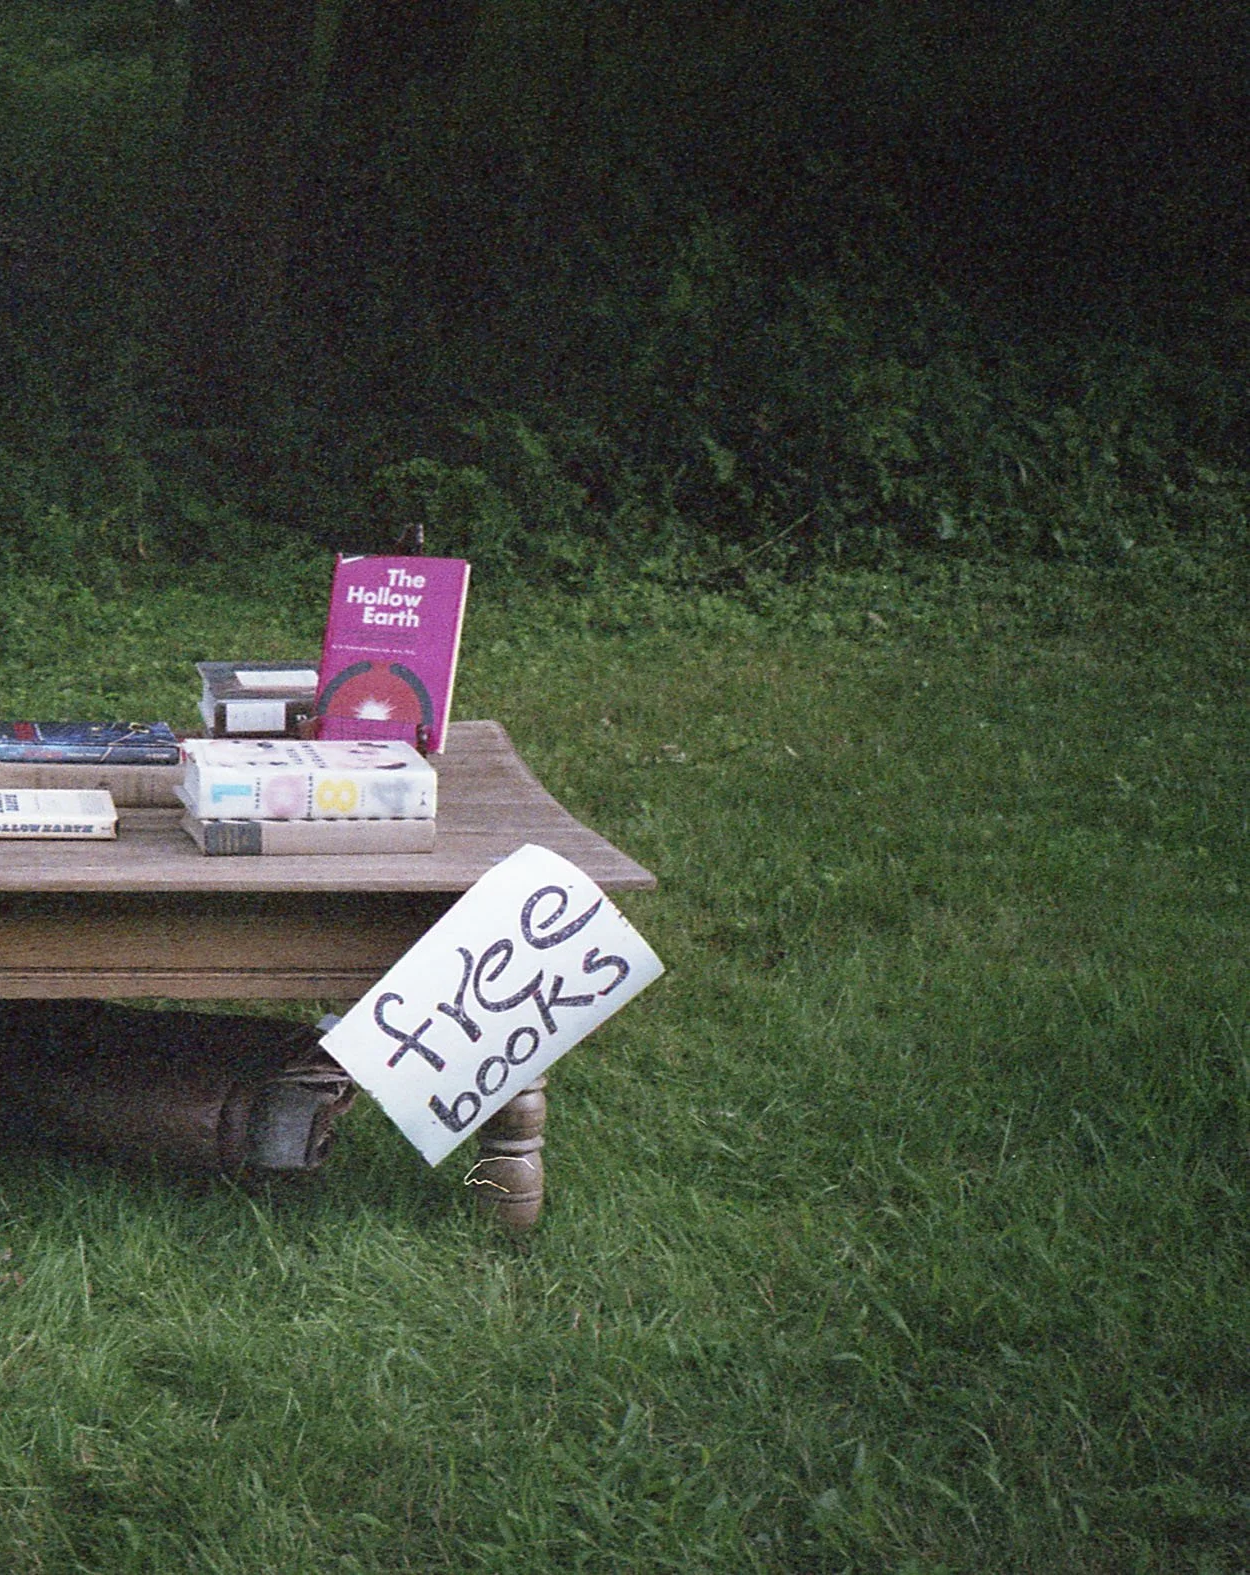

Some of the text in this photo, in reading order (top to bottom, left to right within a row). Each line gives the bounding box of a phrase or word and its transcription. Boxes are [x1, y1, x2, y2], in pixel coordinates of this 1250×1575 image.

[387, 568, 426, 588] The
[346, 585, 422, 607] Hollow
[362, 606, 420, 628] Earth
[373, 885, 603, 1072] free
[428, 947, 631, 1133] books
